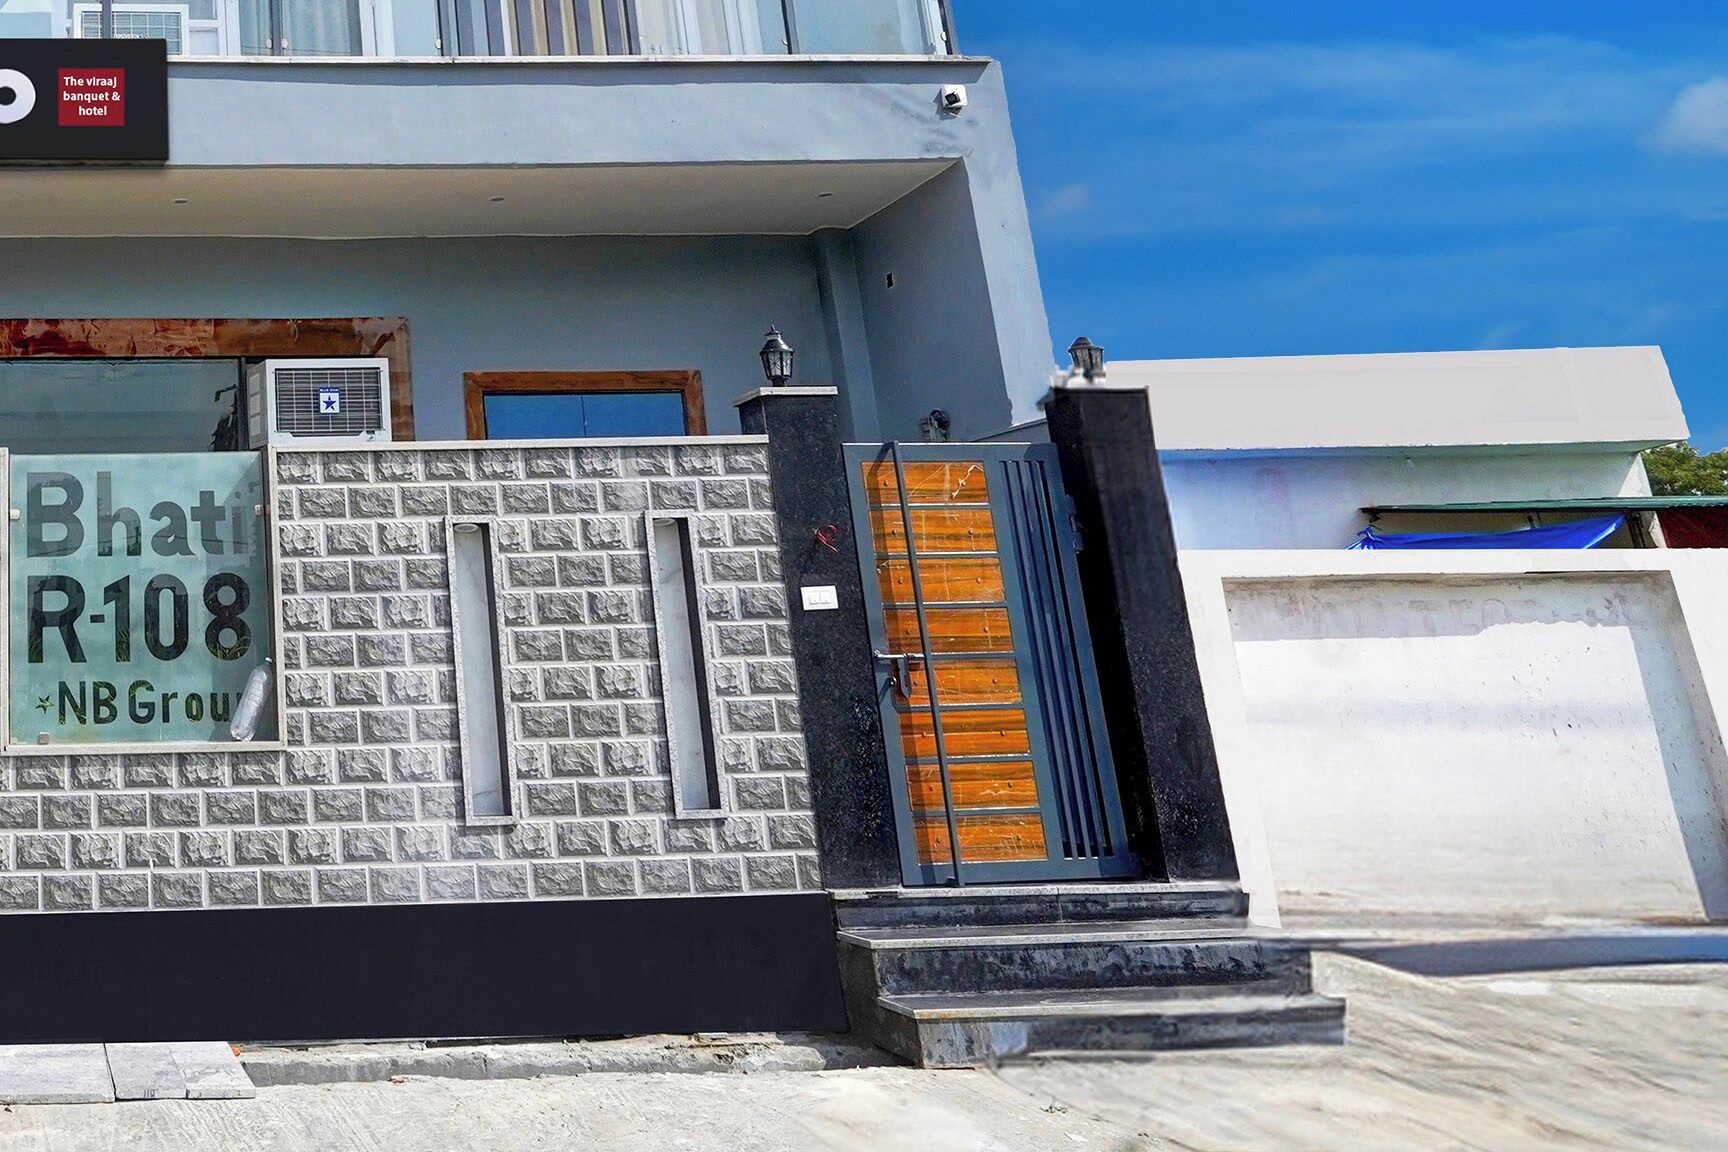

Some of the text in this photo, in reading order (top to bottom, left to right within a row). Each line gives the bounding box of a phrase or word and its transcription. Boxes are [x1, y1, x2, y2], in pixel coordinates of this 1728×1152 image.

[63, 76, 117, 88] The viraaj
[63, 91, 120, 103] banquet &
[79, 105, 107, 116] hotel
[27, 573, 252, 664] R-108
